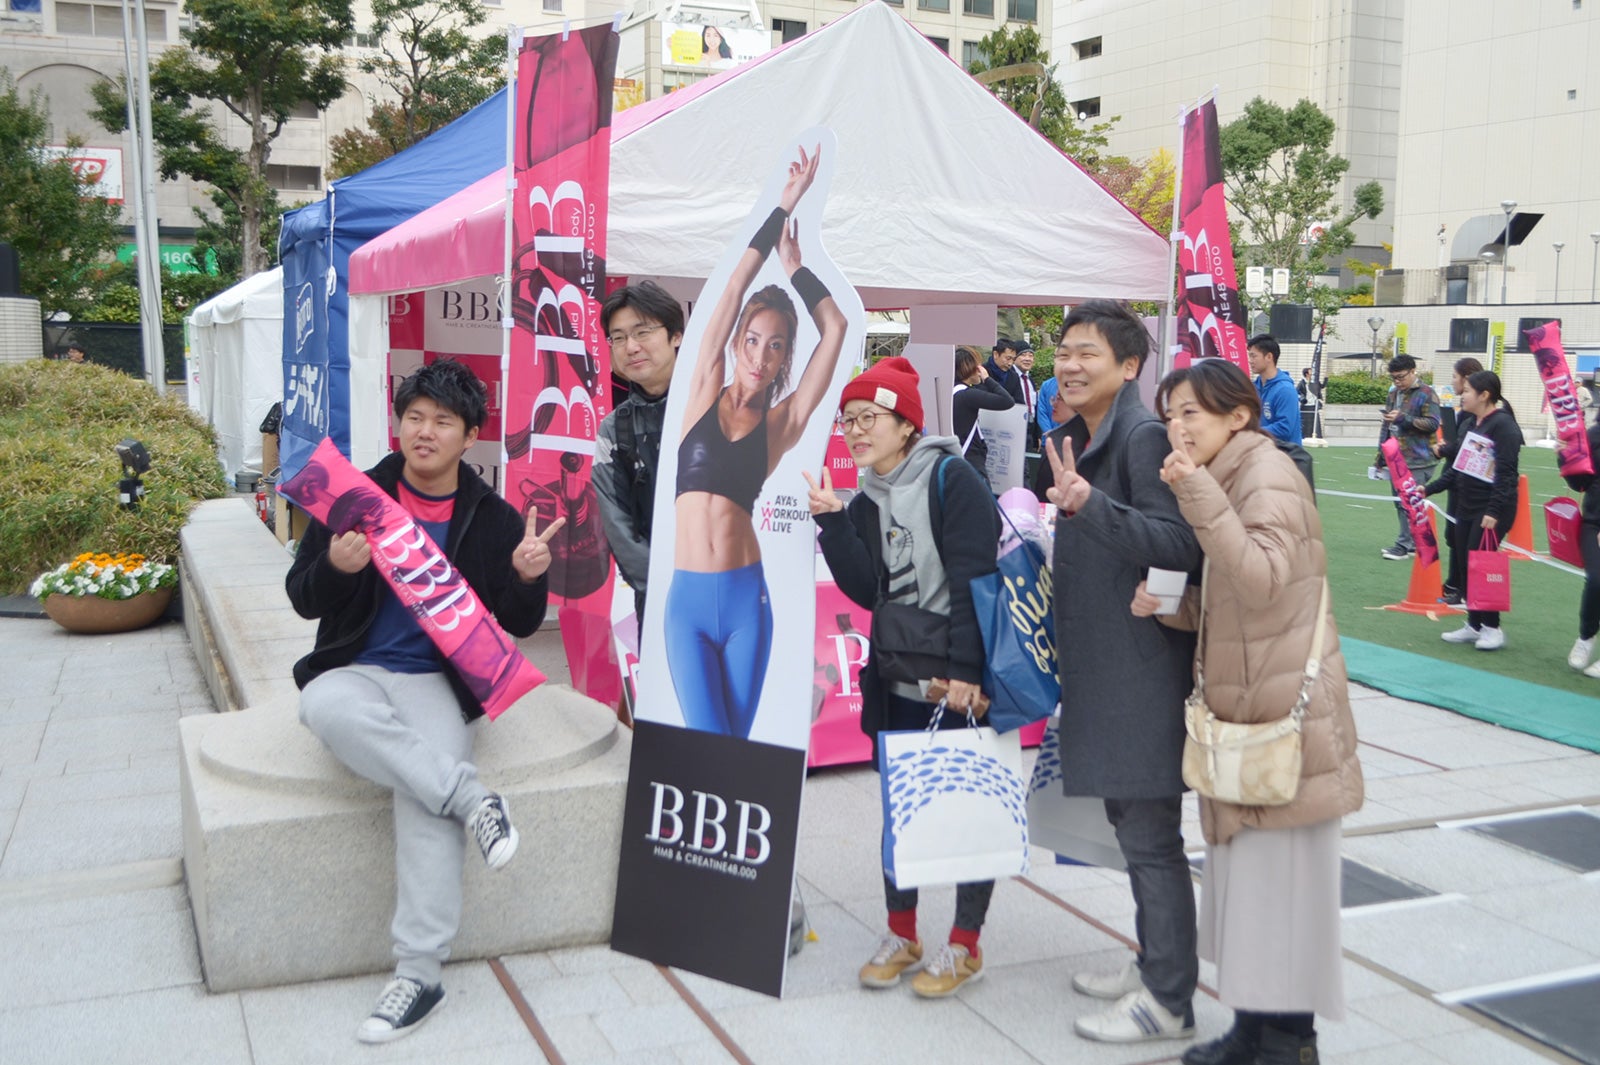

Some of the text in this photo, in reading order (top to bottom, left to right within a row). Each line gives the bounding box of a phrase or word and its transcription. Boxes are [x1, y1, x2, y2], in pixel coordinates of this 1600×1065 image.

[570, 207, 582, 237] ody
[833, 457, 854, 469] BBB
[775, 495, 798, 507] AYA's
[761, 506, 810, 522] WORKOUT
[772, 521, 792, 533] LIVE
[645, 781, 772, 866] B.B.B
[653, 844, 674, 859] HMB
